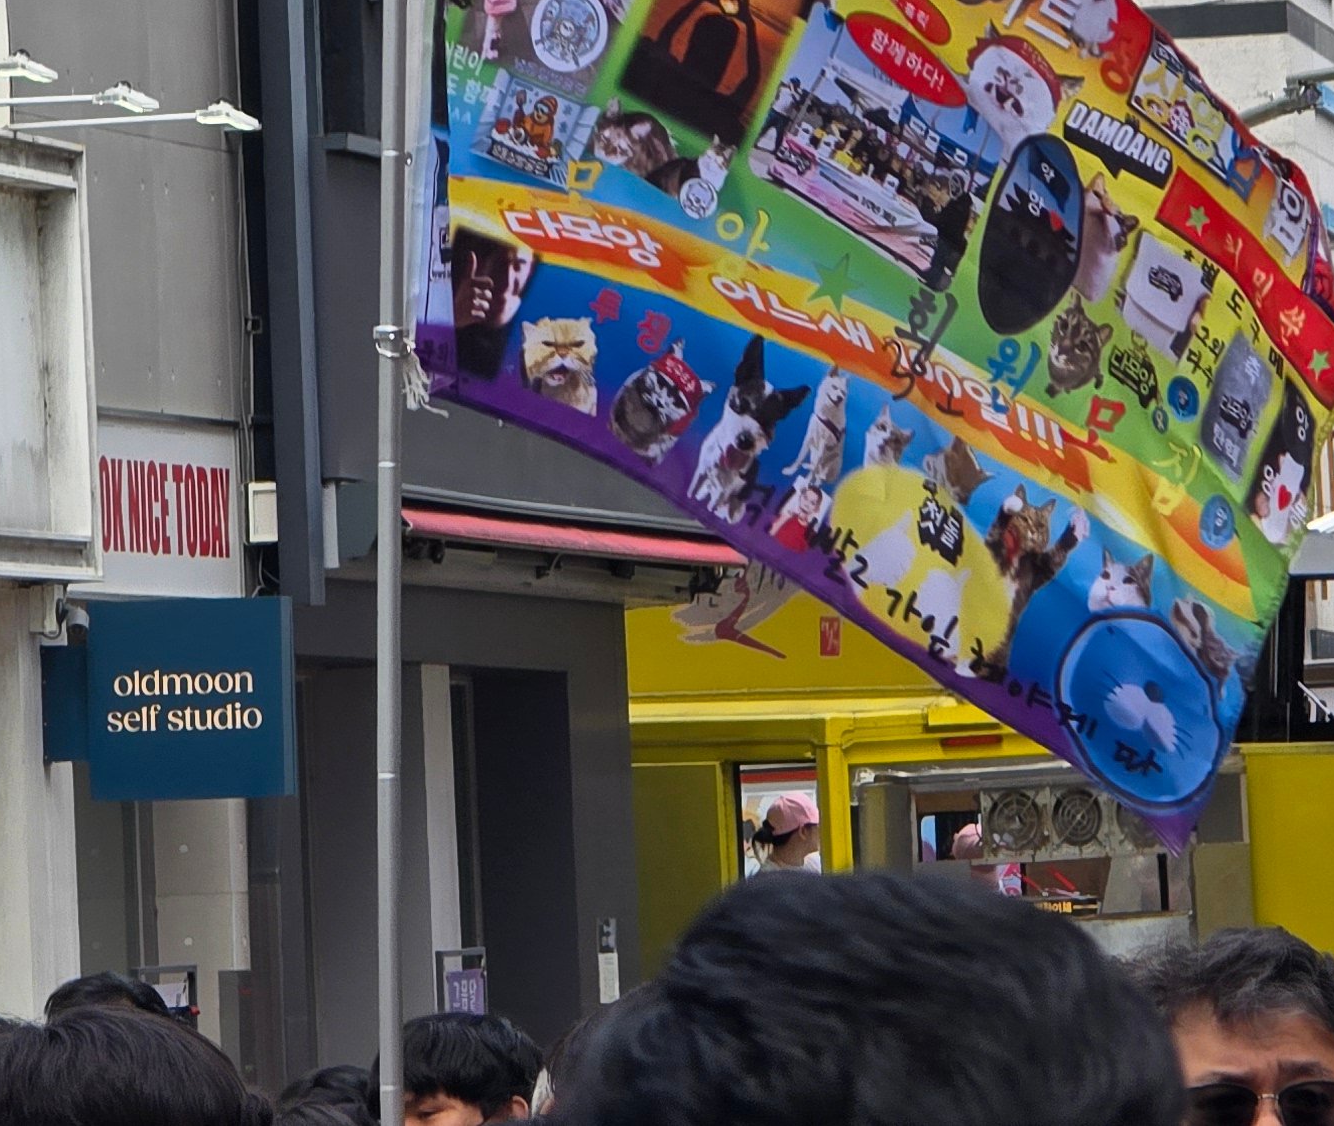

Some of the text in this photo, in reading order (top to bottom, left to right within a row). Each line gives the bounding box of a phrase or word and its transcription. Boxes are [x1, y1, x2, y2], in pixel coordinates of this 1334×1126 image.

[871, 27, 946, 91] 함께하다!
[1065, 101, 1171, 175] DAMOANG
[505, 209, 663, 270] 다모앙
[711, 272, 876, 354] 어느새
[99, 454, 231, 559] OK NICE TODAY
[106, 702, 263, 733] self studio
[113, 671, 254, 698] oldmoon
